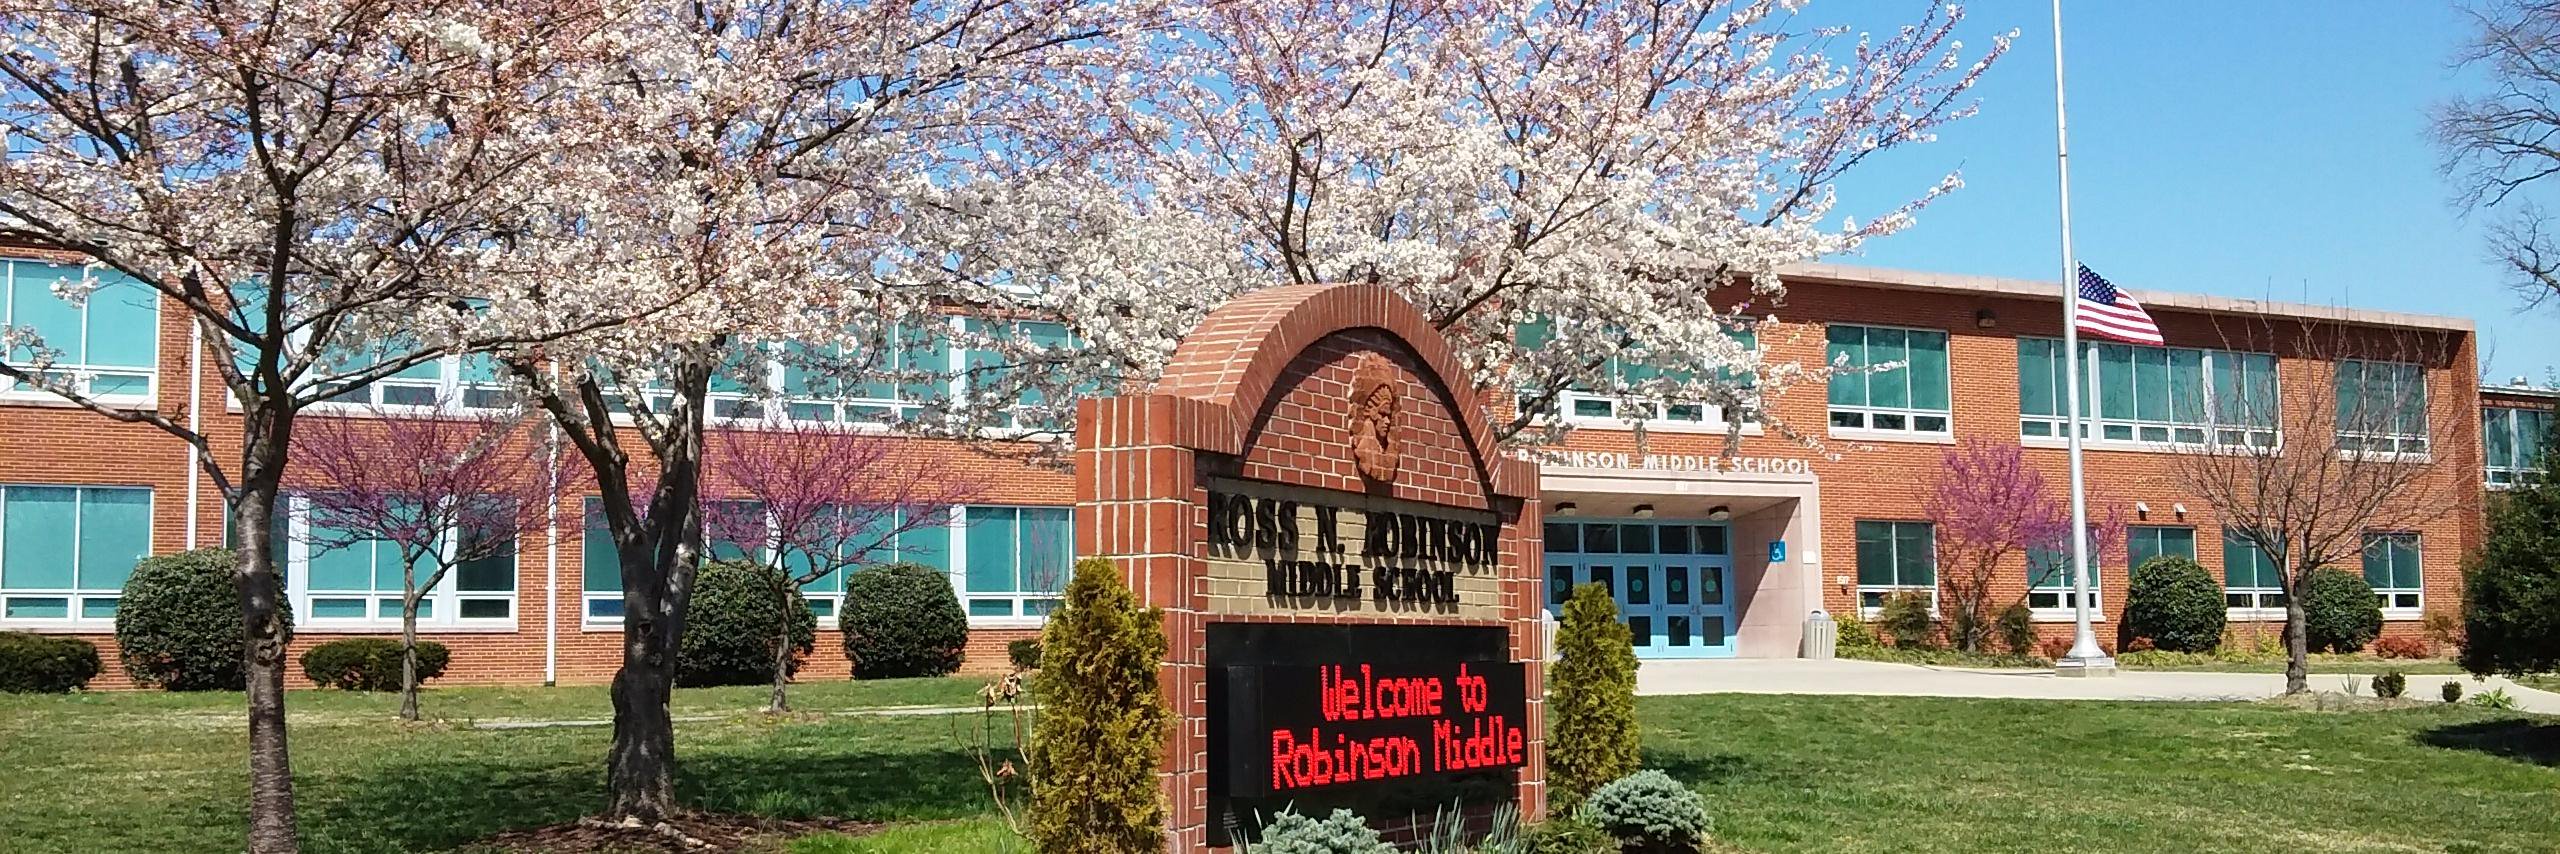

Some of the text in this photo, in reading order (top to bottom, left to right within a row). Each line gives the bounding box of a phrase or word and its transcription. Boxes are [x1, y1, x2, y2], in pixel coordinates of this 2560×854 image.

[1643, 454, 1718, 471] MIDDLE
[1731, 456, 1813, 474] SCHOOL
[1207, 489, 1498, 567] ROSS N. ROBINSON
[1265, 559, 1460, 603] MIDDLE SCHOOL
[1320, 662, 1488, 722] Welcome to
[1272, 715, 1523, 790] Robinson Middle
